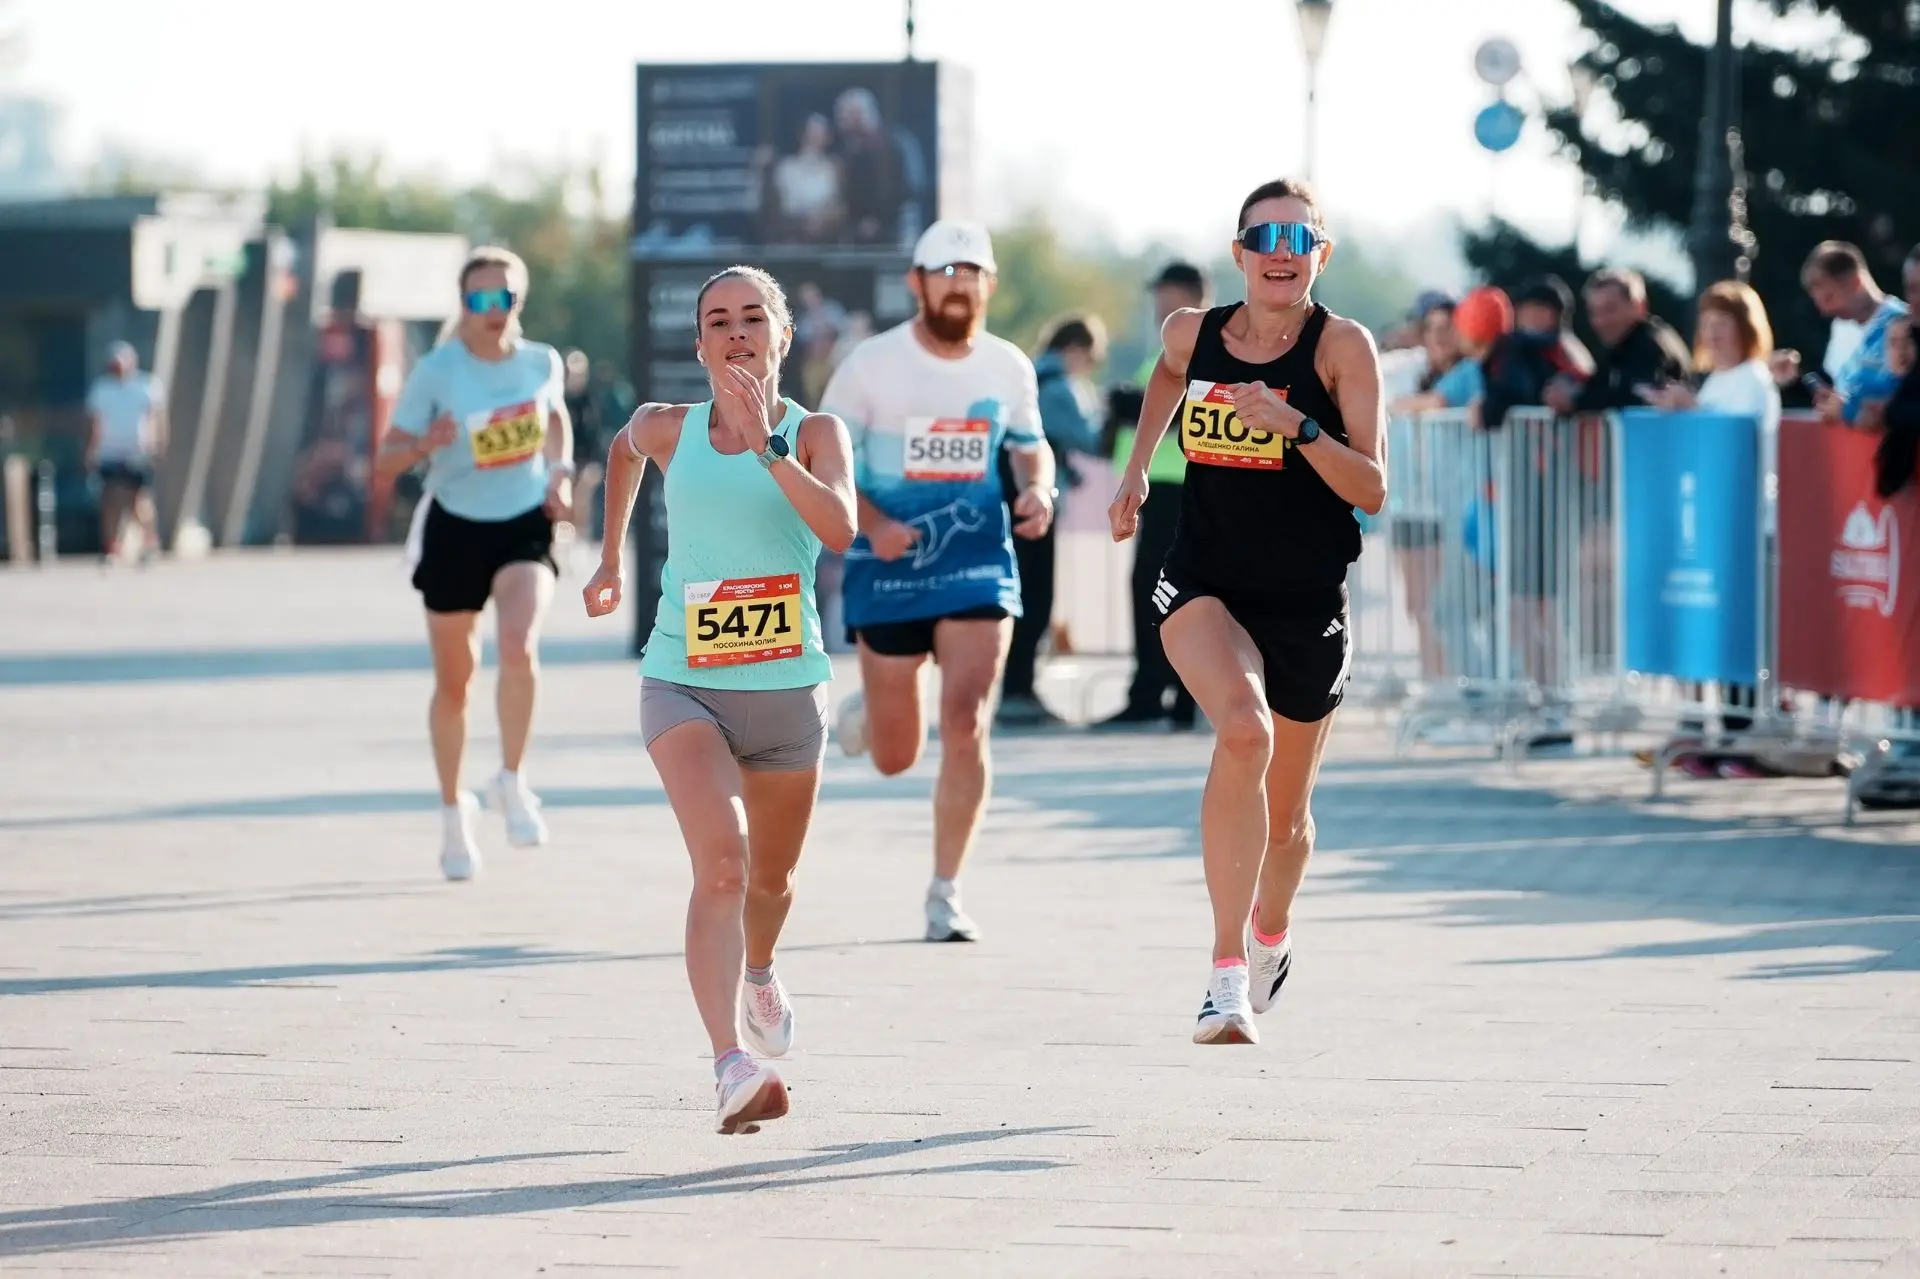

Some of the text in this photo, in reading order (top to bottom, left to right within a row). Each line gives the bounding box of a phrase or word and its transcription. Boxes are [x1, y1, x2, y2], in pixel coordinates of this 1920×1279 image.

[909, 436, 983, 462] 5888
[1232, 445, 1260, 453] ГАЛИНА
[697, 601, 791, 642] 5471
[713, 637, 777, 650] ПОСОХИНА ЮЛИЯ
